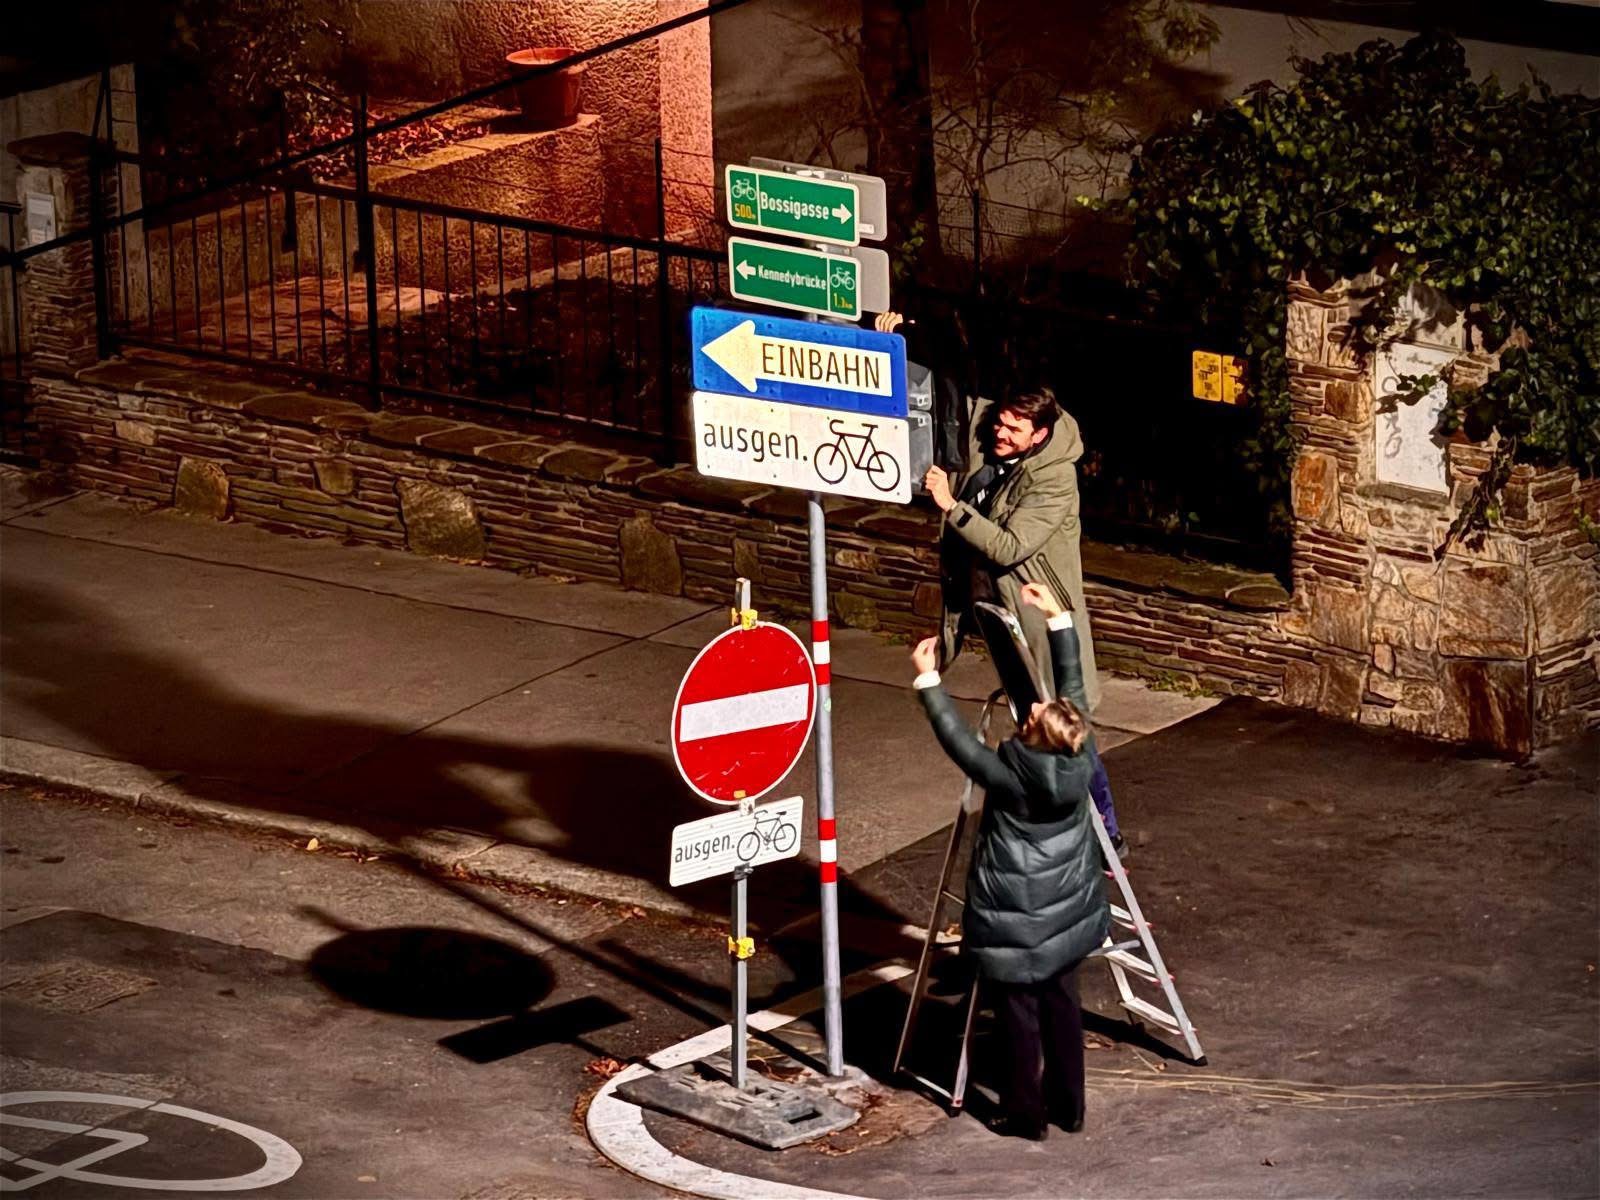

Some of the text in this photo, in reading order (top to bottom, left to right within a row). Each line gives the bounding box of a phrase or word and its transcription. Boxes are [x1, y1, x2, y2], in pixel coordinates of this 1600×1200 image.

[760, 191, 830, 221] Bossigasse
[757, 264, 827, 291] Kennedybrücke
[761, 342, 880, 389] EINBAHN
[703, 423, 808, 463] ausgen.
[674, 834, 735, 863] ausgen.
